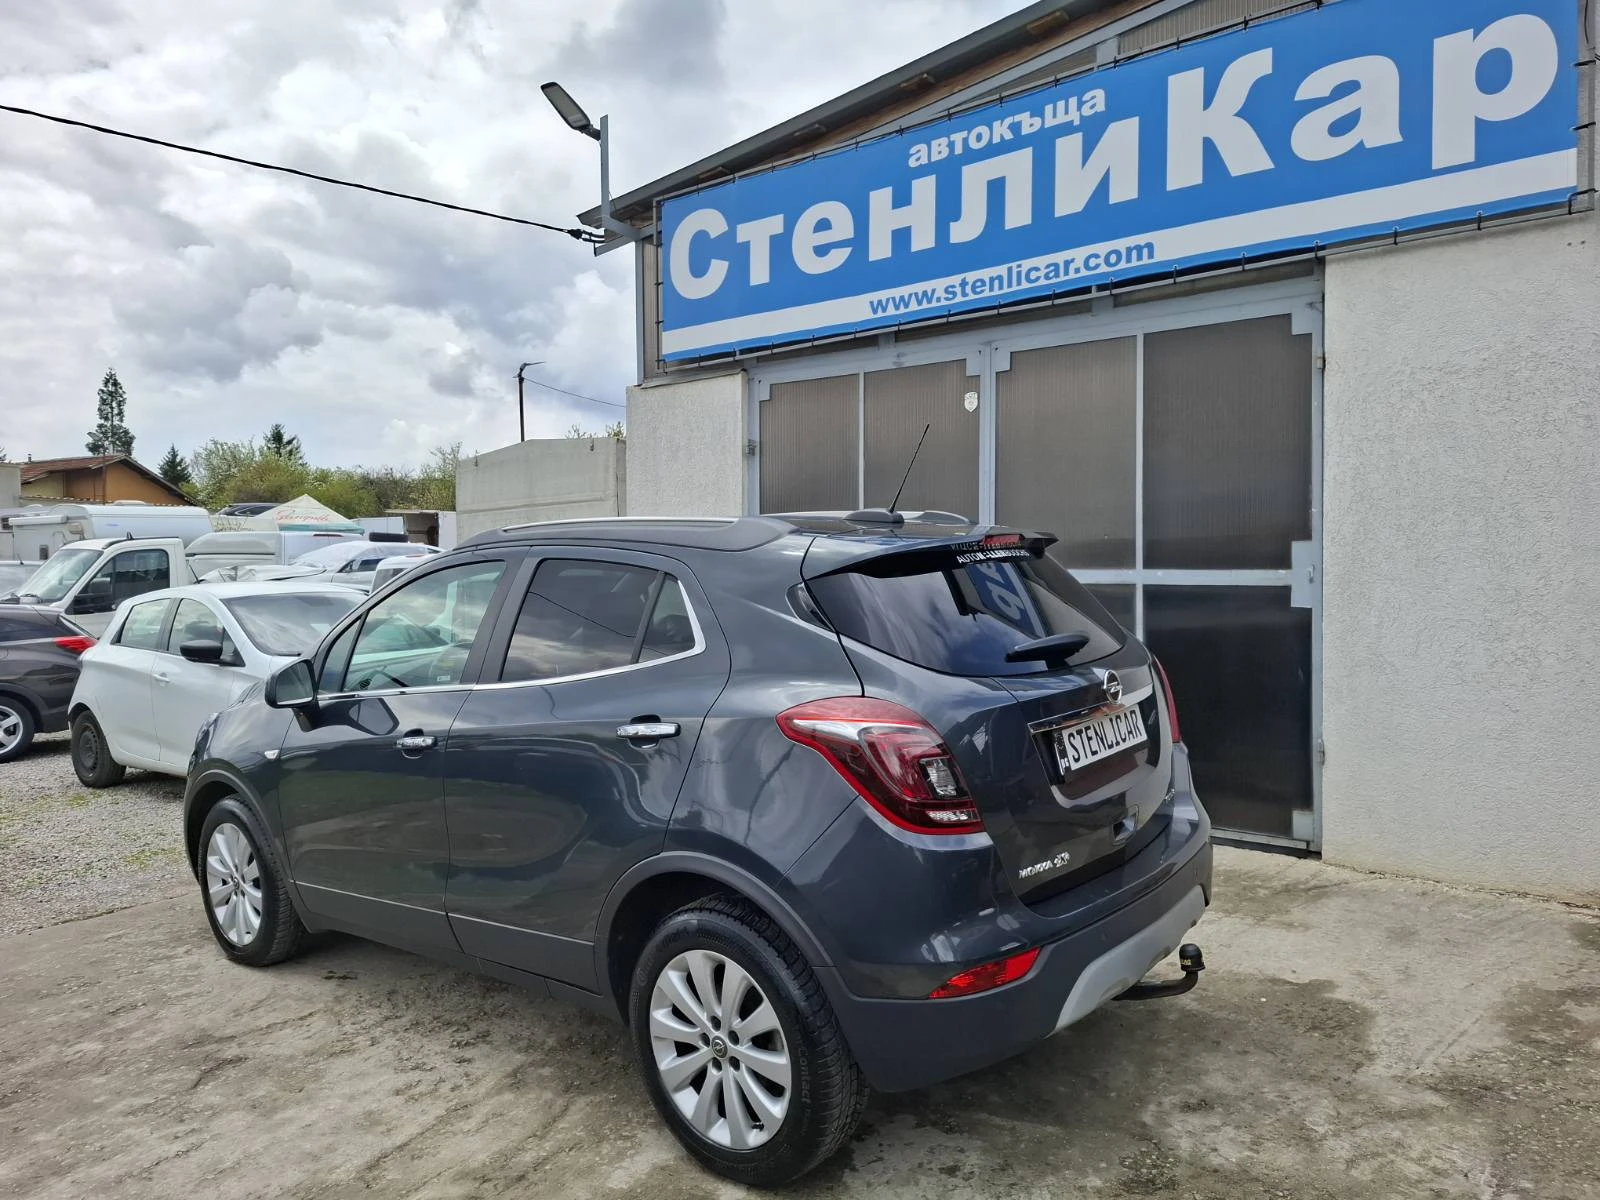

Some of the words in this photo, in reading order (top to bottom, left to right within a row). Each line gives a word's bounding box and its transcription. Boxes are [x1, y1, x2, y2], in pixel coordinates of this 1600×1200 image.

[669, 13, 1559, 300] СтенлиКар
[908, 88, 1106, 168] автокъща
[869, 241, 1155, 316] www.stenlicar.com
[1067, 709, 1143, 763] STENLICAR
